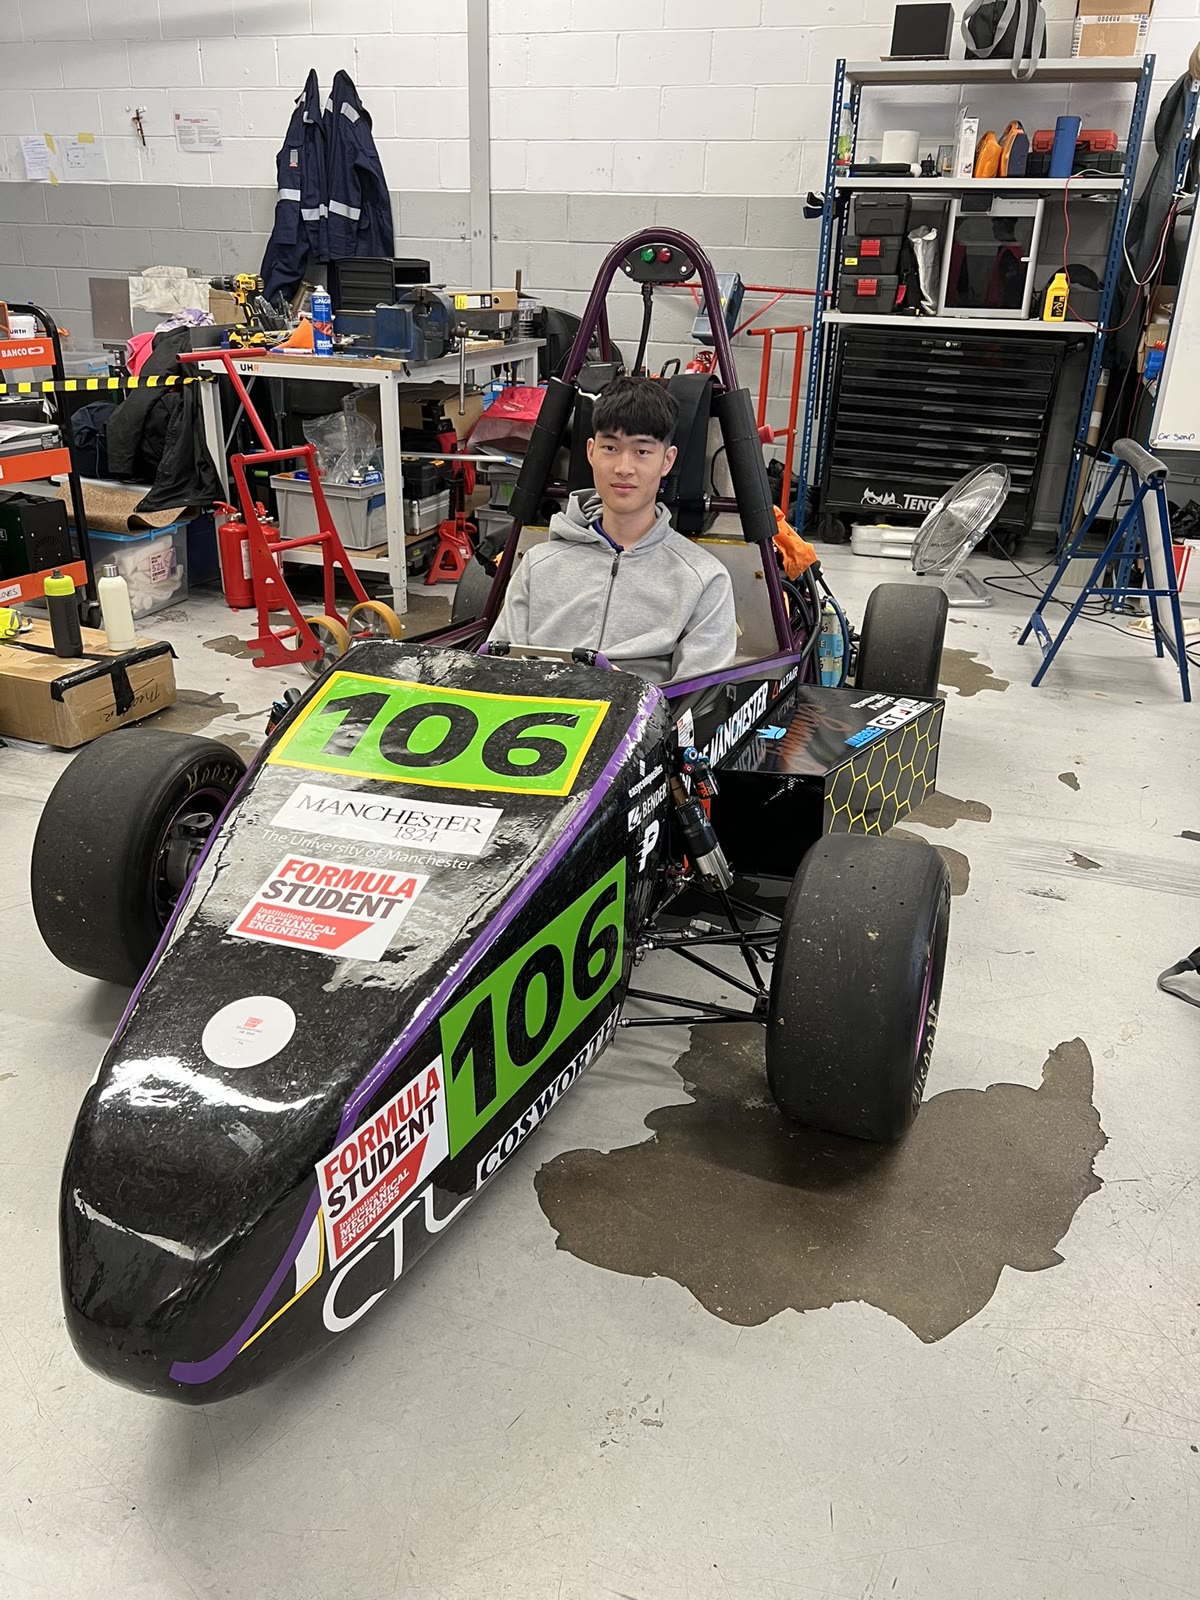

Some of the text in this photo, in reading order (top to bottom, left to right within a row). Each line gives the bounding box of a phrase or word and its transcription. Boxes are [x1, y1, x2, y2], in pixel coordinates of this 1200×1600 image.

[1, 348, 28, 358] BAHCO
[240, 364, 260, 372] UHR
[778, 665, 799, 694] ALTAIR
[318, 691, 581, 778] 106
[709, 680, 769, 769] MANCHESTER
[296, 794, 482, 834] MANCHESTER
[642, 782, 668, 819] BENDER
[261, 829, 475, 870] The University of Manchester
[392, 826, 438, 843] 1824
[278, 858, 418, 899] FORMULA
[259, 906, 303, 921] Institution
[261, 879, 404, 920] STUDENT
[246, 920, 320, 941] ENGINEERS
[252, 912, 337, 936] MECHANICAL
[450, 880, 620, 1119] 106
[480, 1010, 619, 1183] COSWORTH
[322, 1066, 441, 1192] FORMULA
[328, 1094, 439, 1220] STUDENT
[339, 1180, 387, 1231] Institution of
[340, 1167, 410, 1240] MECHANICAL
[340, 1186, 400, 1250] ENGINEERS
